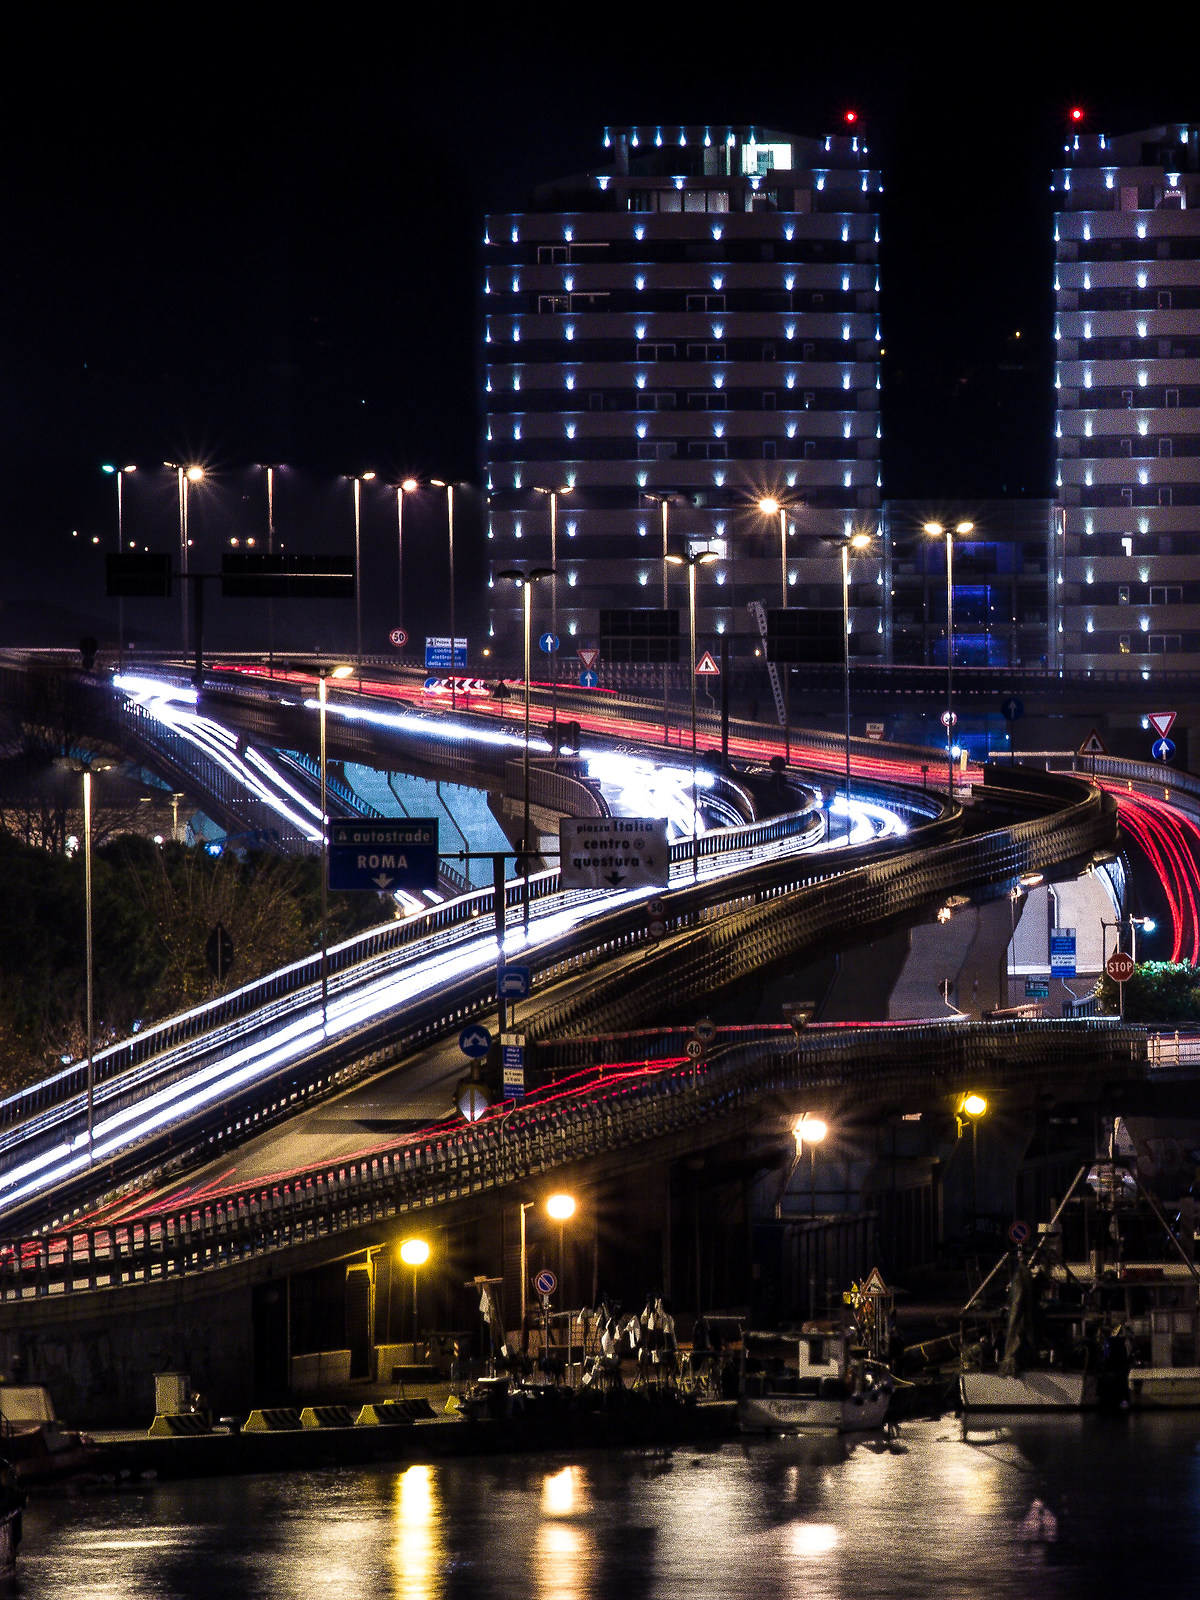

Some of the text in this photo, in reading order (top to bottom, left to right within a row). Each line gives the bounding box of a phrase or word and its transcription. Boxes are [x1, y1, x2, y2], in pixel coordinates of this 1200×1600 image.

[393, 632, 405, 642] 50
[576, 821, 653, 834] piazza Italia
[353, 828, 430, 842] autostrade
[583, 838, 630, 850] centro
[357, 854, 409, 869] ROMA
[573, 856, 640, 870] questura
[651, 902, 663, 912] 50
[1109, 961, 1132, 973] STOP
[688, 1043, 700, 1055] 40
